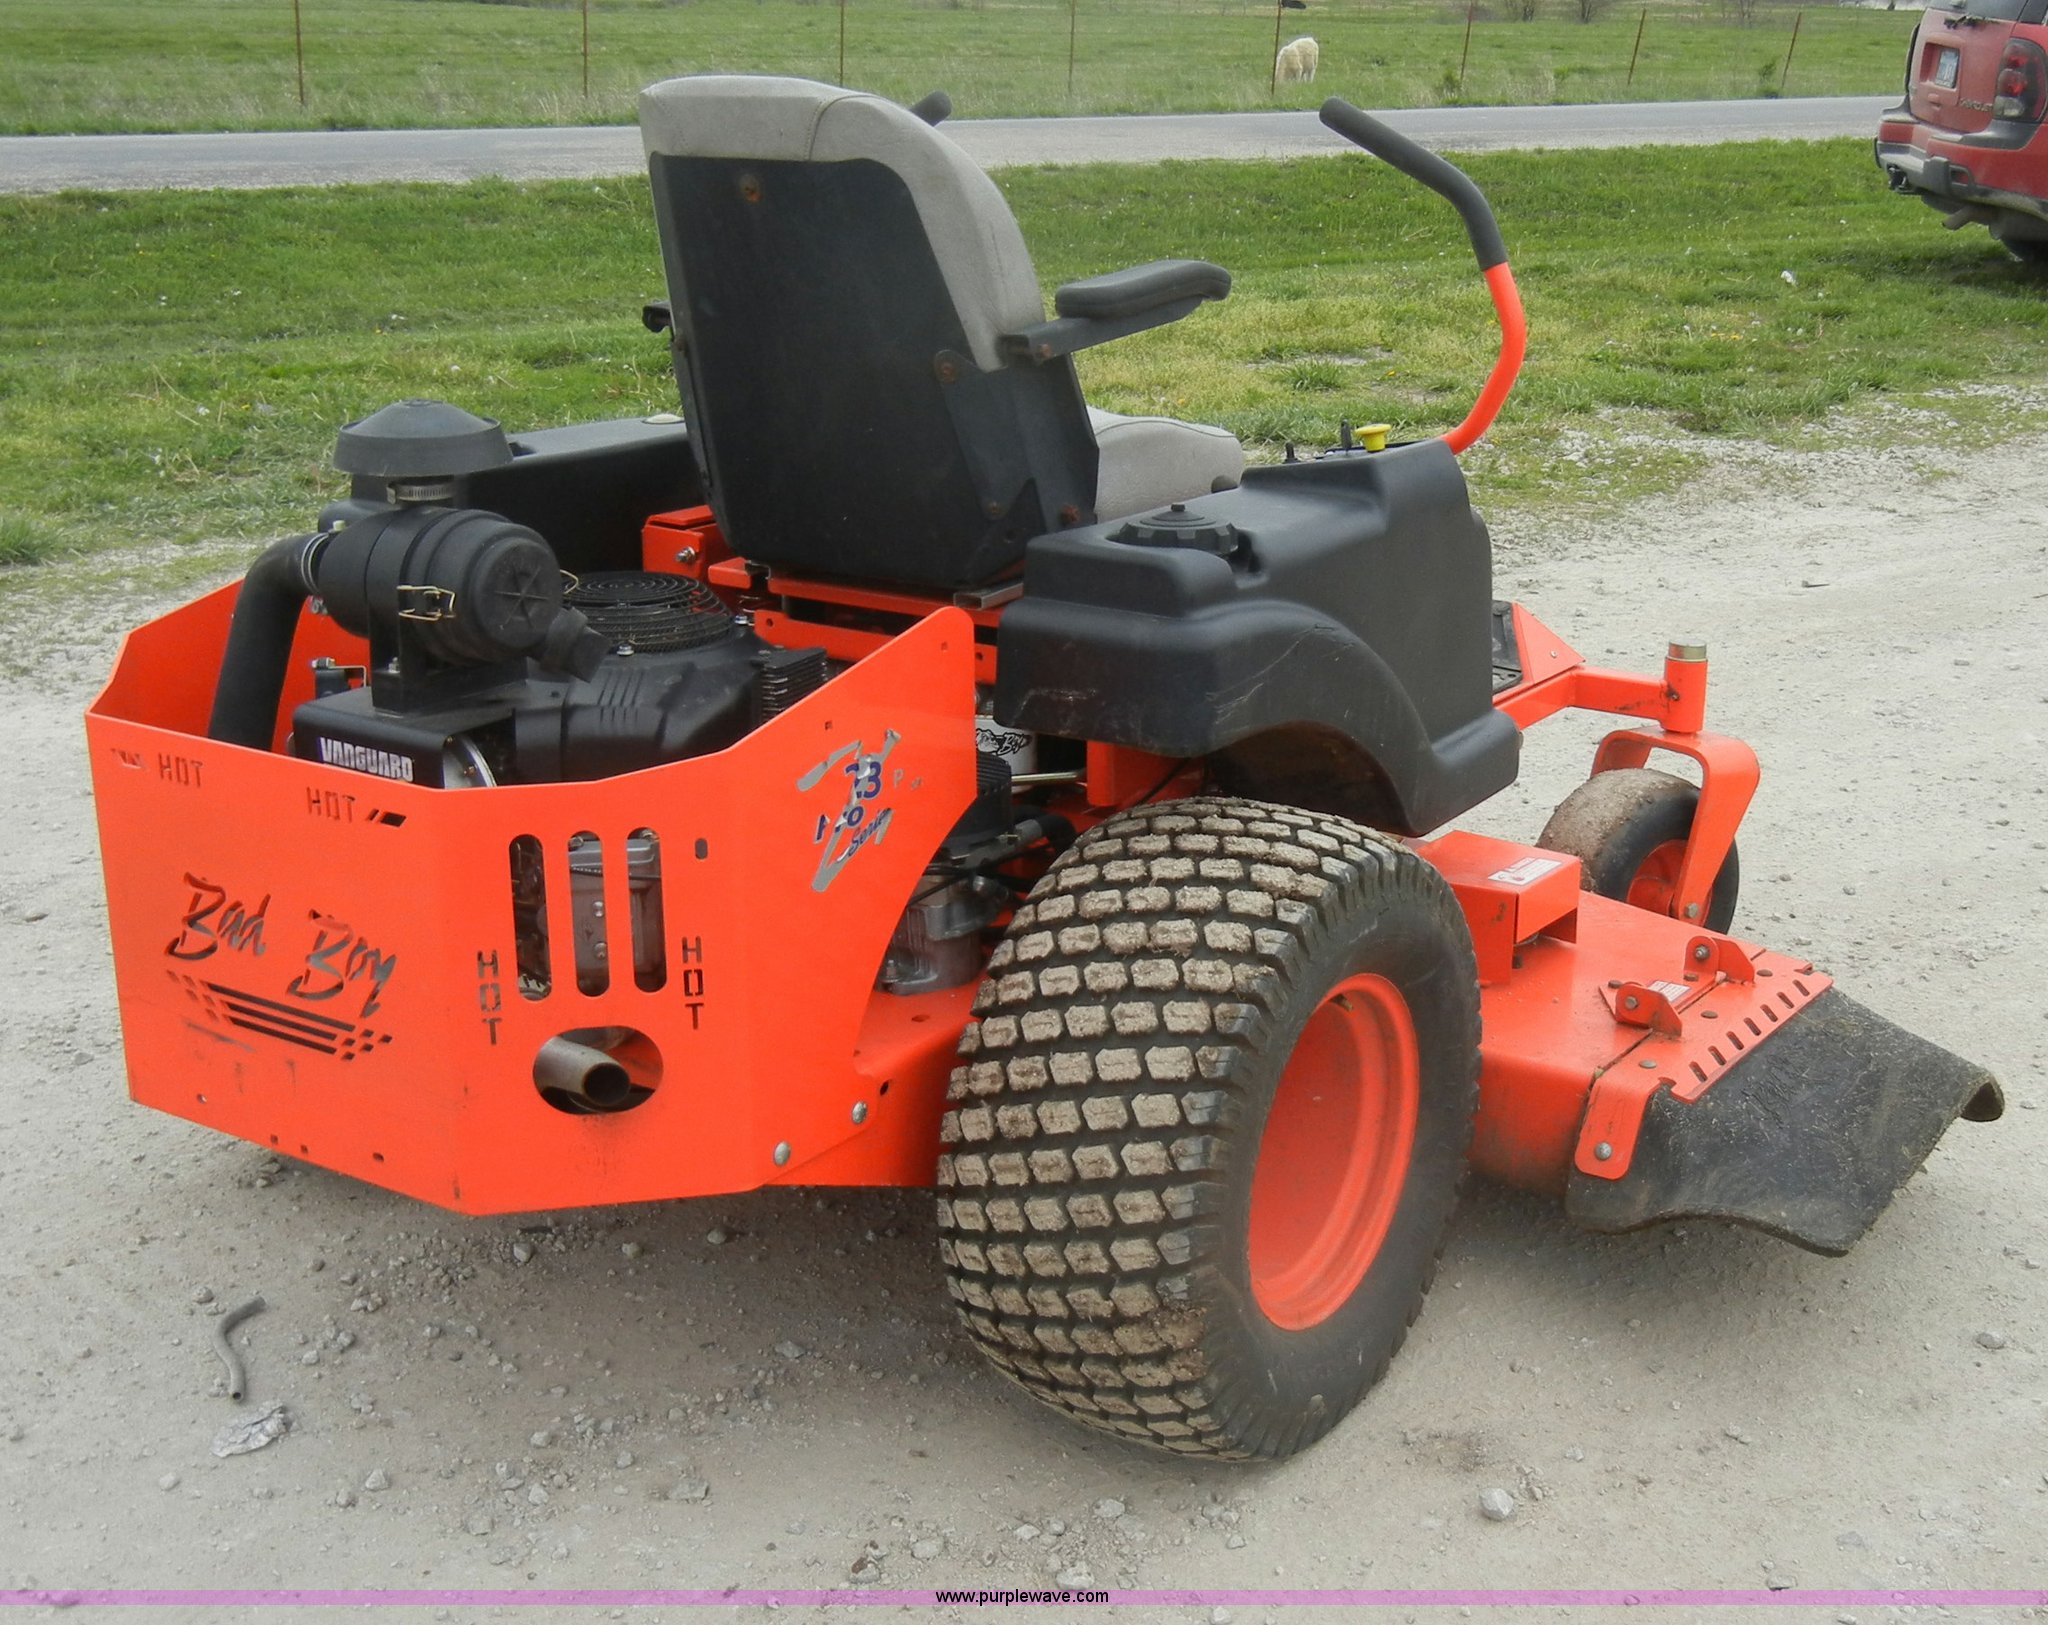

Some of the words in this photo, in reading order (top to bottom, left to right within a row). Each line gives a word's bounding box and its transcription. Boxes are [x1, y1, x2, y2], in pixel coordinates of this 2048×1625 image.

[157, 752, 204, 788] HOT
[319, 736, 414, 783] VANGUARD
[306, 786, 356, 823] HOT
[164, 871, 271, 961] Bad
[286, 908, 397, 1018] Boy
[477, 949, 502, 1045] HOT
[681, 936, 704, 1030] HOT
